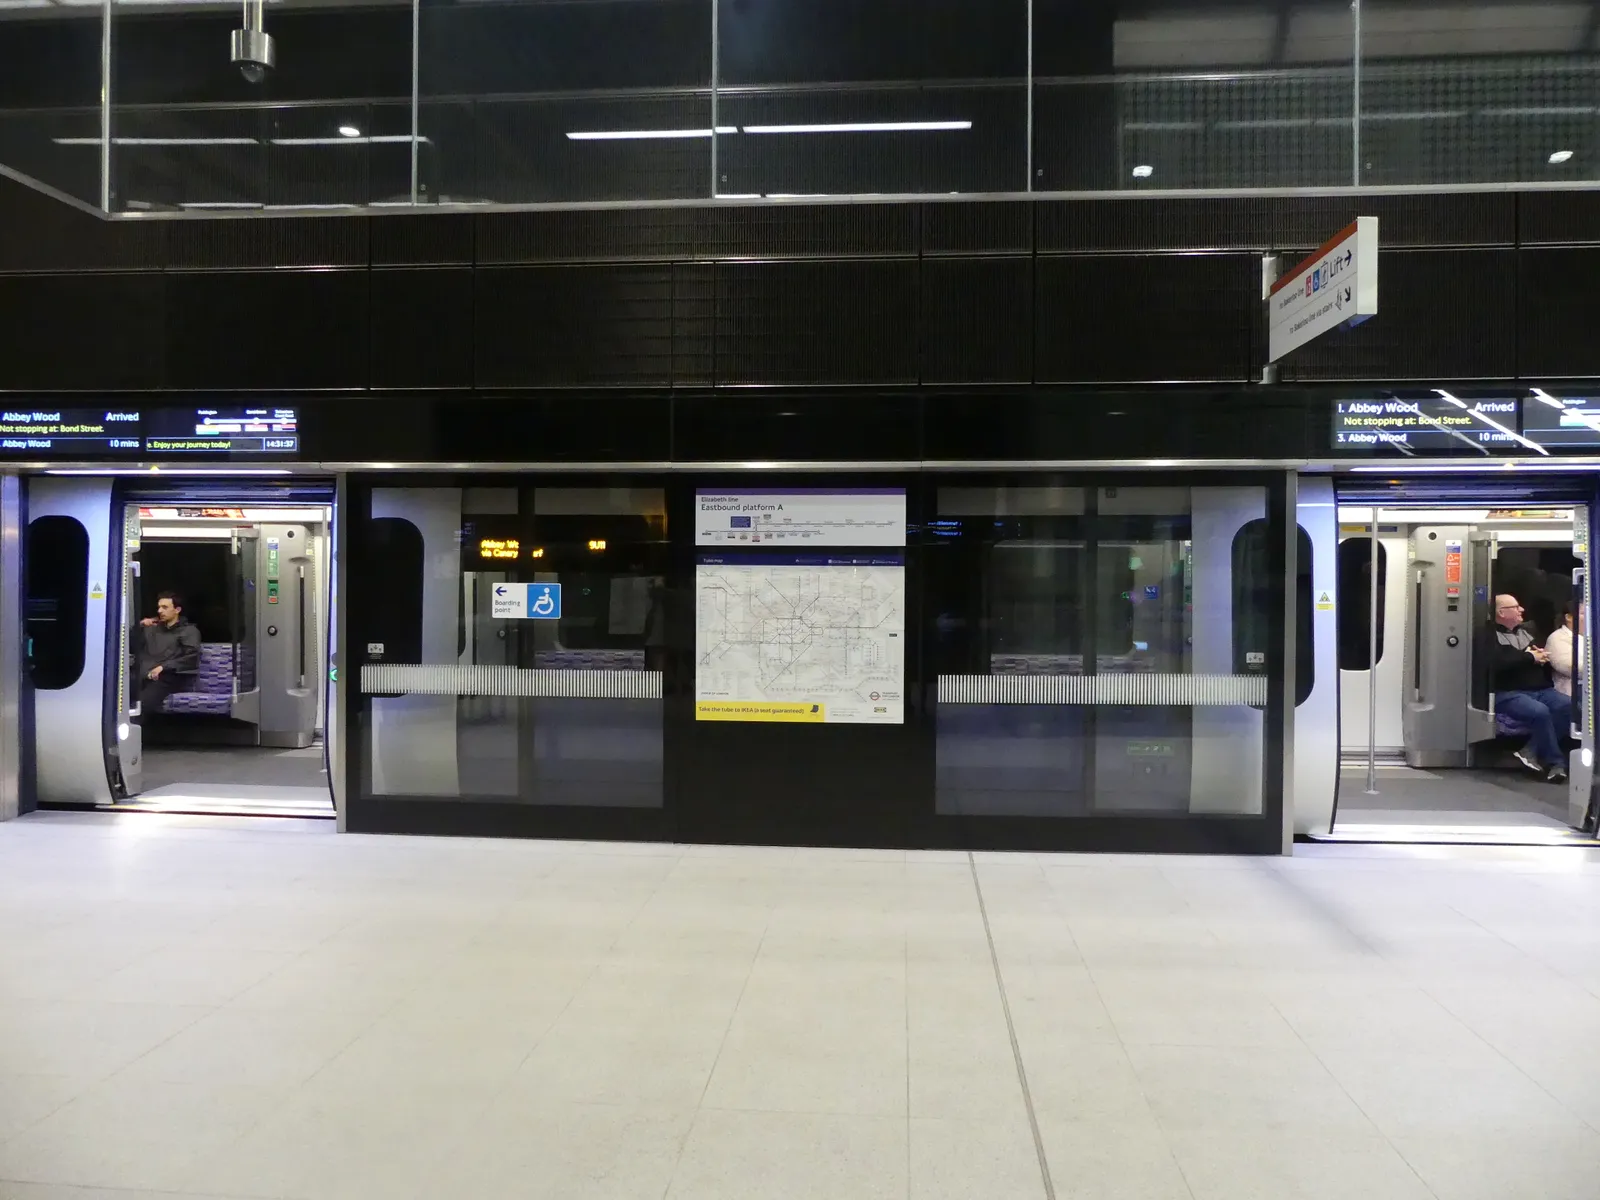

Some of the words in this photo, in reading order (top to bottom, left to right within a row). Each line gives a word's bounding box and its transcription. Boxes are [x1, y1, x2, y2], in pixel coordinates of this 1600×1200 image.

[1330, 256, 1343, 278] Lift
[1349, 402, 1381, 415] Abbey
[1385, 402, 1418, 413] Wood
[1475, 401, 1515, 412] Arrived
[3, 412, 31, 423] Abbey
[33, 412, 60, 421] Wood
[106, 412, 140, 421] Arrived
[1343, 416, 1362, 426] Not
[1363, 416, 1403, 427] stopping
[1404, 416, 1417, 426] at:
[1418, 415, 1441, 425] Bond
[1442, 415, 1472, 425] Street.
[0, 425, 14, 433] Not
[15, 425, 48, 434] stopping
[60, 424, 80, 432] Bond
[80, 424, 104, 433] Street.
[1337, 433, 1346, 443] 3.
[1348, 432, 1377, 443] Abbey
[1380, 432, 1407, 442] Wood
[1479, 432, 1491, 441] 10
[3, 440, 27, 449] Abbey
[28, 440, 51, 448] Wood
[110, 440, 119, 448] 10
[120, 440, 140, 448] mins
[153, 441, 171, 449] Enjoy
[186, 441, 210, 449] journey
[266, 440, 294, 448] 14:31:37
[701, 503, 740, 511] Eastbound
[742, 503, 776, 512] platform
[481, 540, 506, 549] Abbey
[493, 549, 519, 559] Canary
